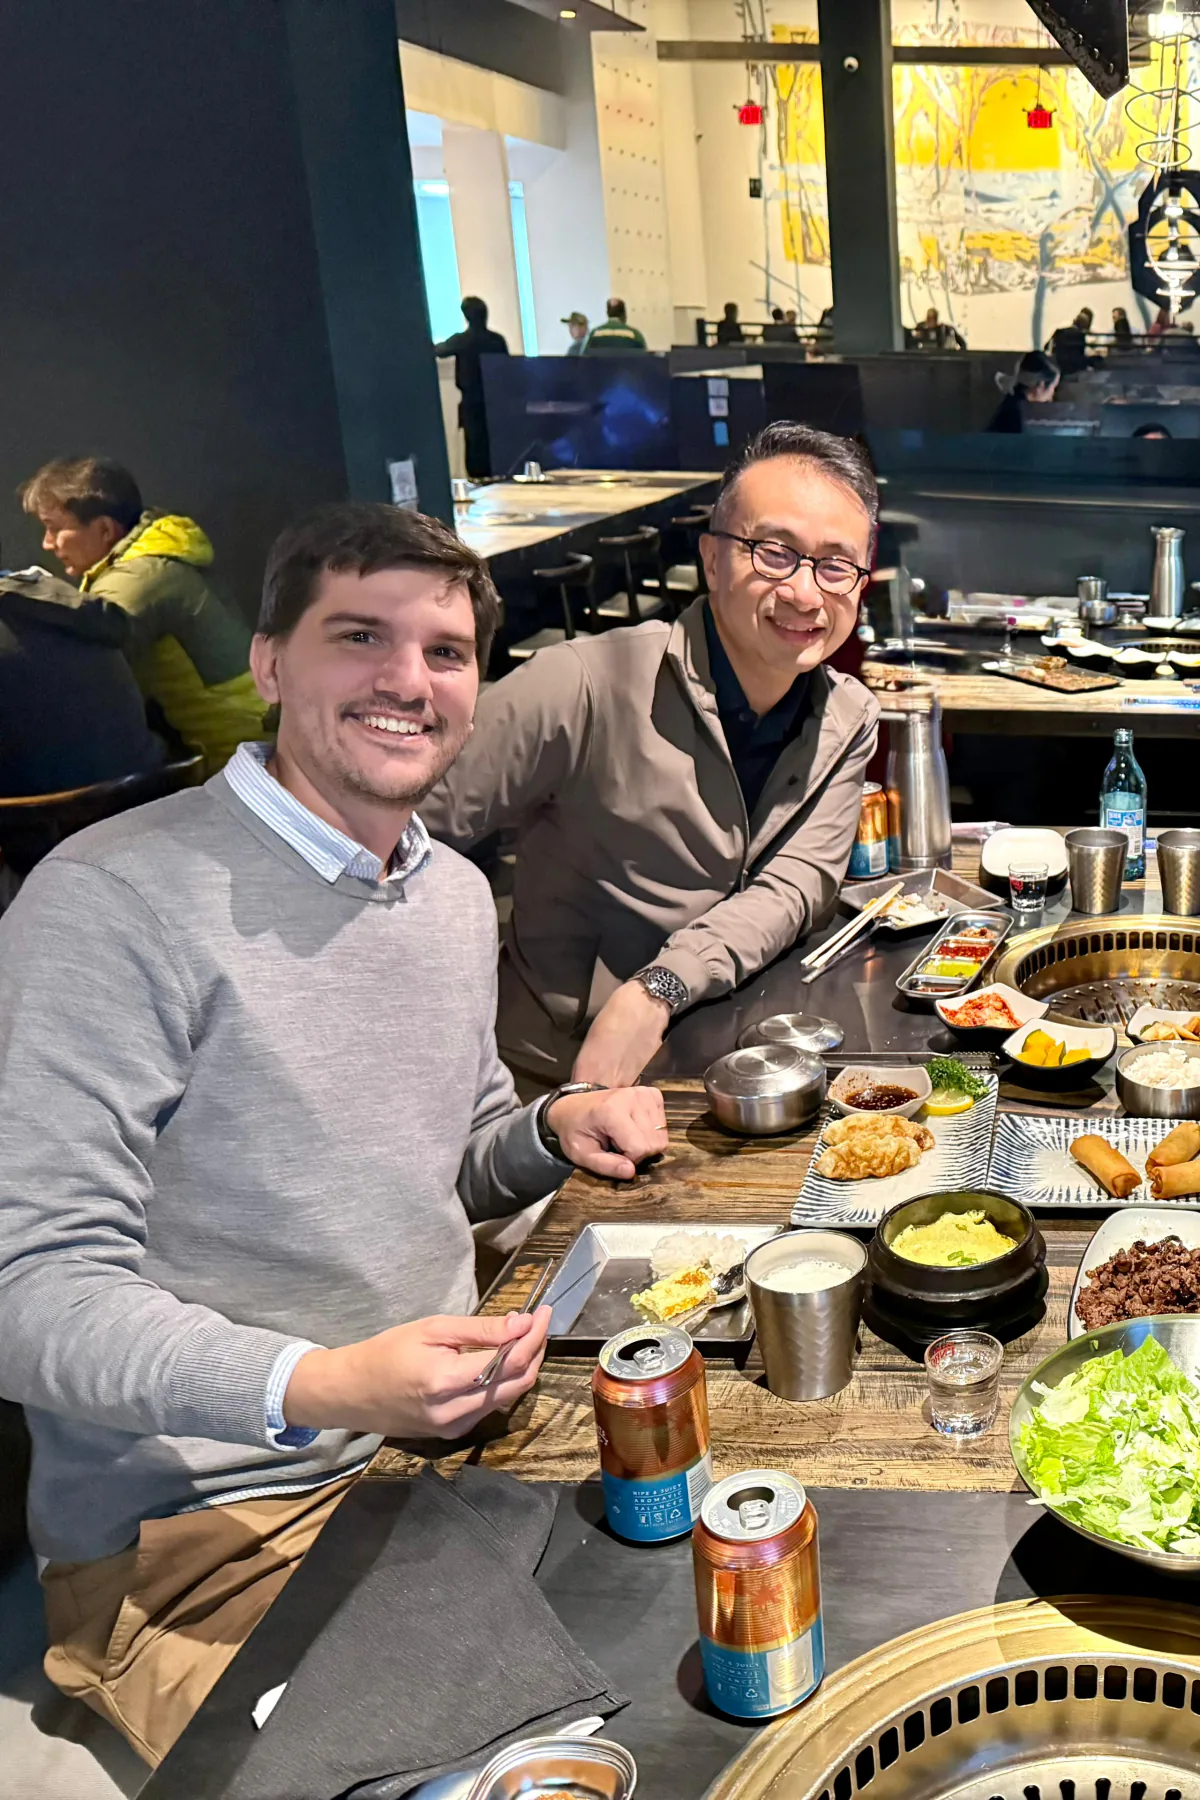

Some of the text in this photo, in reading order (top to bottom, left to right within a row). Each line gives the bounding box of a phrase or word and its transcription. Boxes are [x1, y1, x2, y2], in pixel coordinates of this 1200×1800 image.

[661, 1483, 682, 1494] JUICY
[634, 1491, 682, 1504] AROMATIC
[634, 1499, 684, 1511] BALANCED
